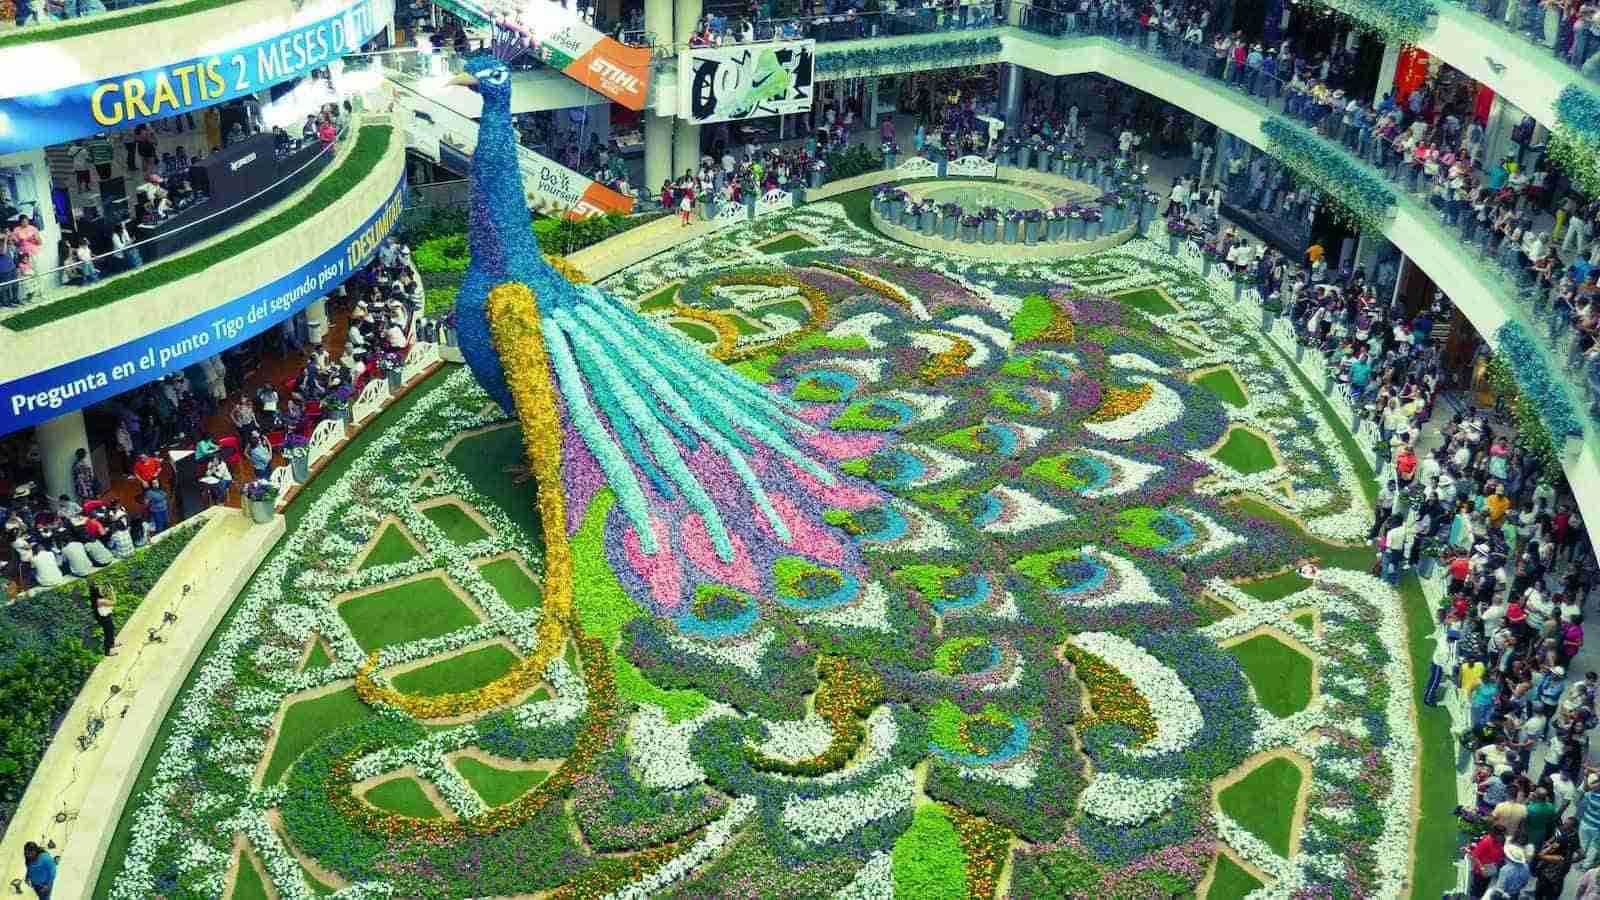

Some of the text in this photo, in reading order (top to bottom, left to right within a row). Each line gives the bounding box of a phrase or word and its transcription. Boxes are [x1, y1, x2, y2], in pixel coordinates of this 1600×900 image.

[91, 55, 226, 127] GRATIS
[231, 53, 250, 91] 2
[256, 25, 329, 84] MESES
[590, 57, 641, 94] STIHL
[540, 166, 558, 185] Do
[11, 370, 109, 416] Pregunta
[111, 361, 136, 381] en
[139, 346, 156, 370] el
[158, 331, 210, 368] punto
[211, 314, 245, 339] Tigo
[247, 303, 269, 325] del
[270, 274, 317, 313] segundo
[317, 262, 338, 291] piso
[336, 258, 345, 281] y
